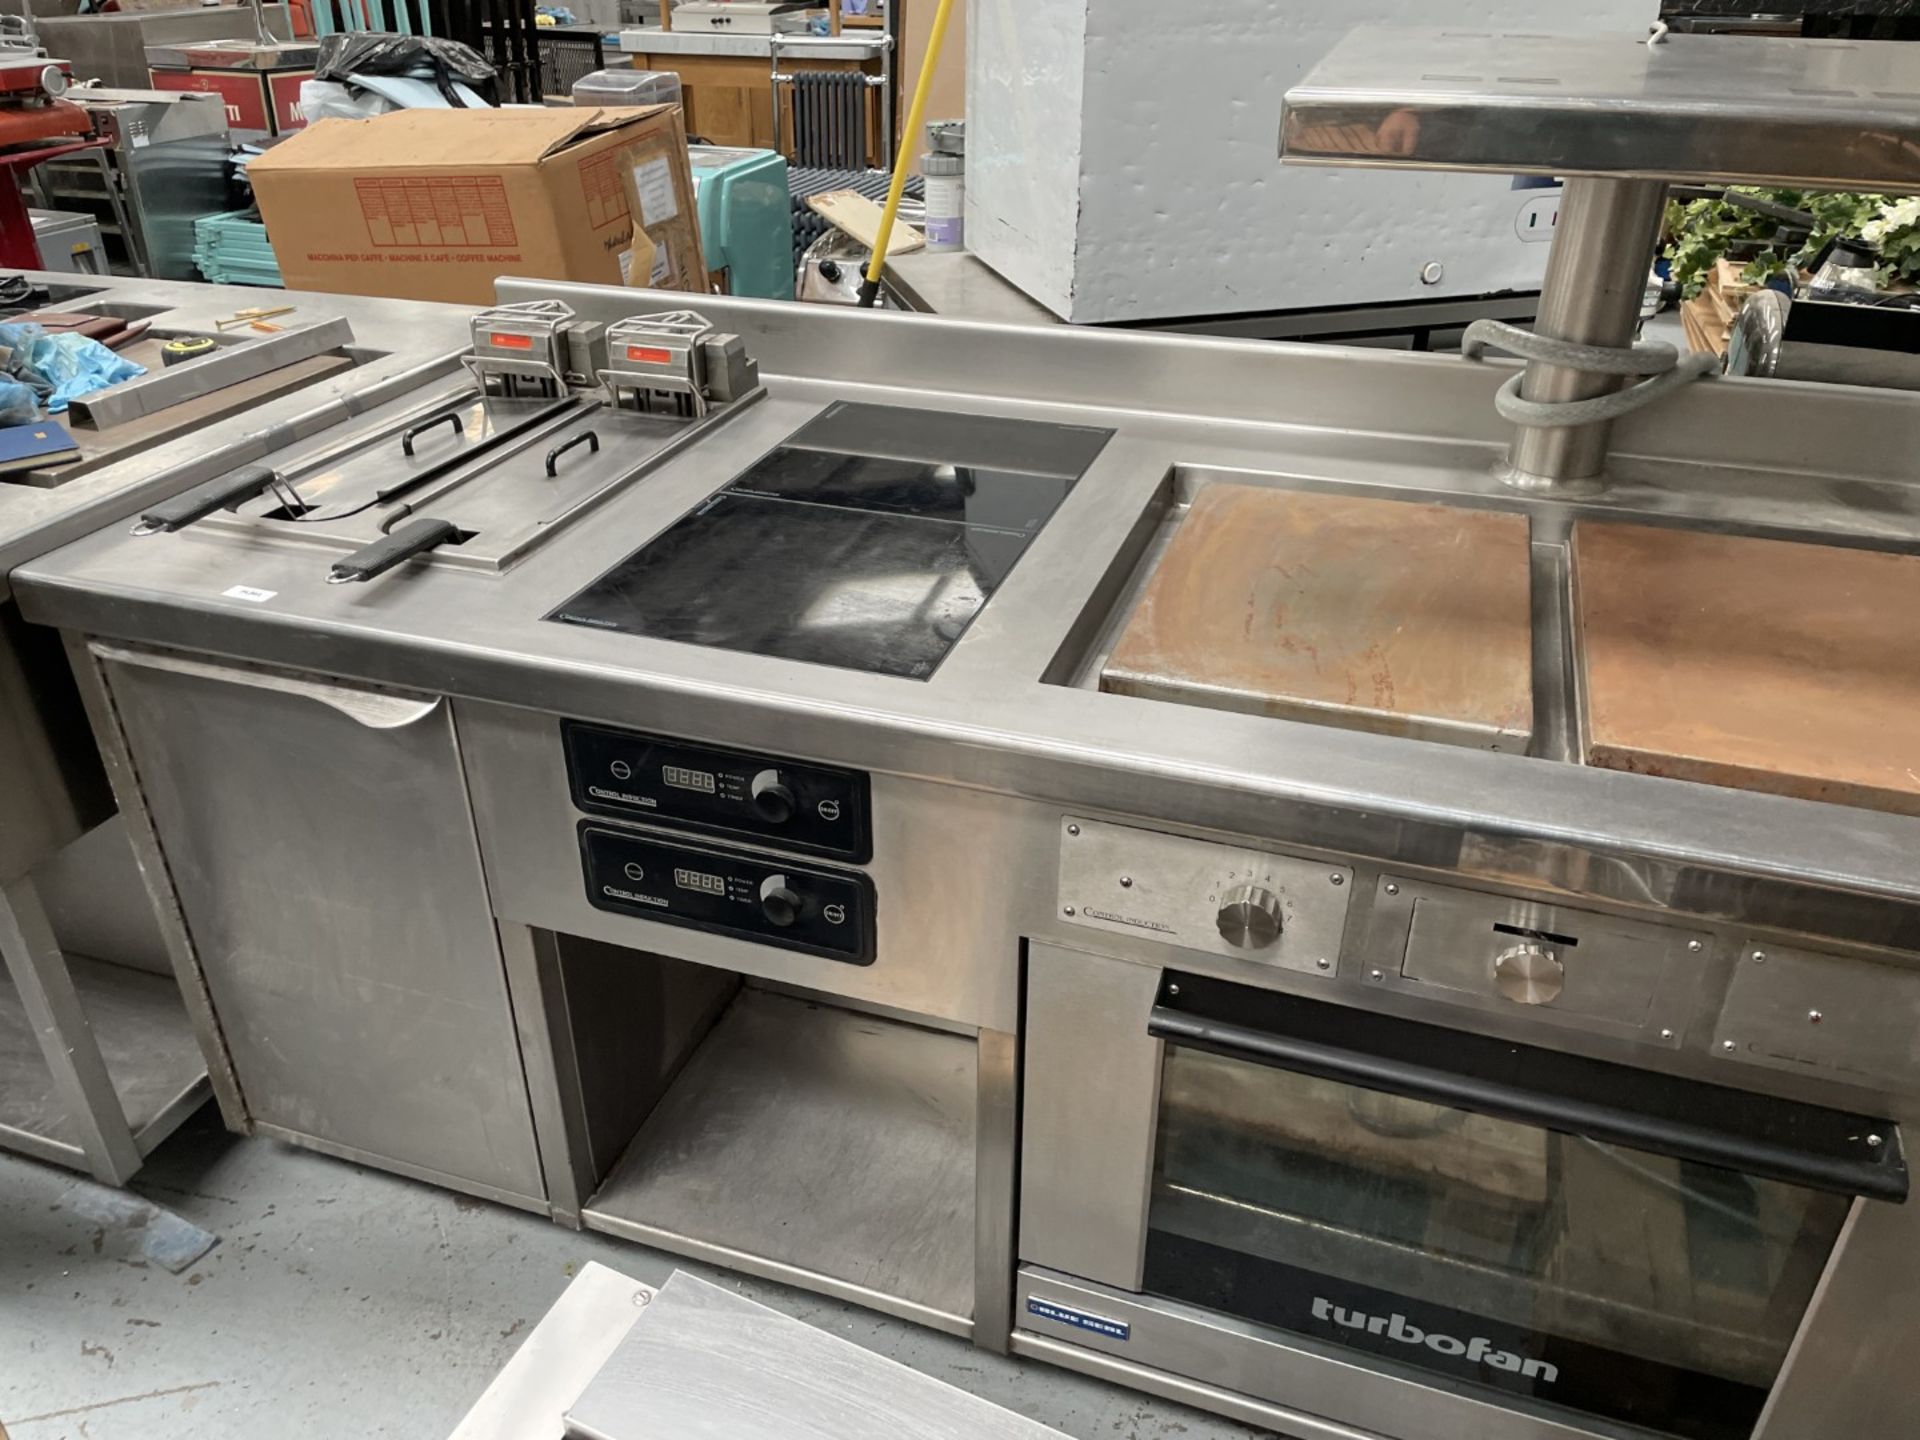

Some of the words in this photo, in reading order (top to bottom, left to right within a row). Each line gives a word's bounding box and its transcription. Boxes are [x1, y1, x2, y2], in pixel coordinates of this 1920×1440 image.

[289, 101, 304, 121] M
[486, 253, 522, 263] MACHINE
[1311, 1296, 1559, 1383] turbofan
